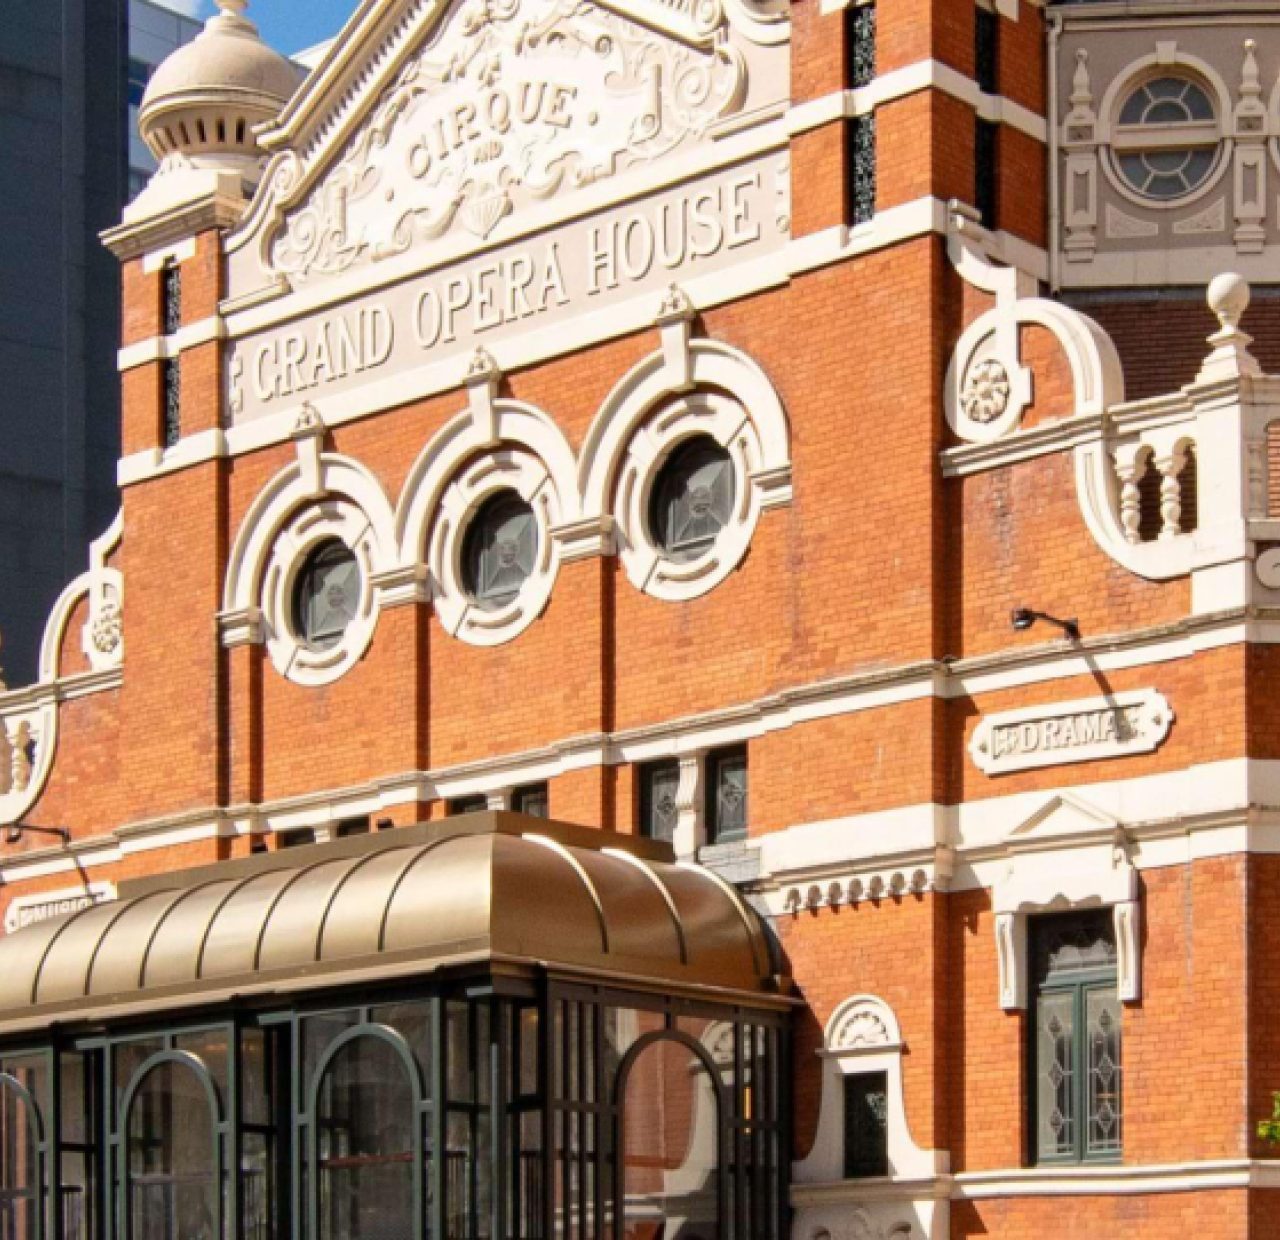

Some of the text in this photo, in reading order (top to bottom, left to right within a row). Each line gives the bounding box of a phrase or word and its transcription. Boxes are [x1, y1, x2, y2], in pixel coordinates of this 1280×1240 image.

[407, 82, 578, 179] CIRQUE
[254, 173, 761, 402] GRAND OPERA HOUSE
[1020, 711, 1119, 753] DRAMA
